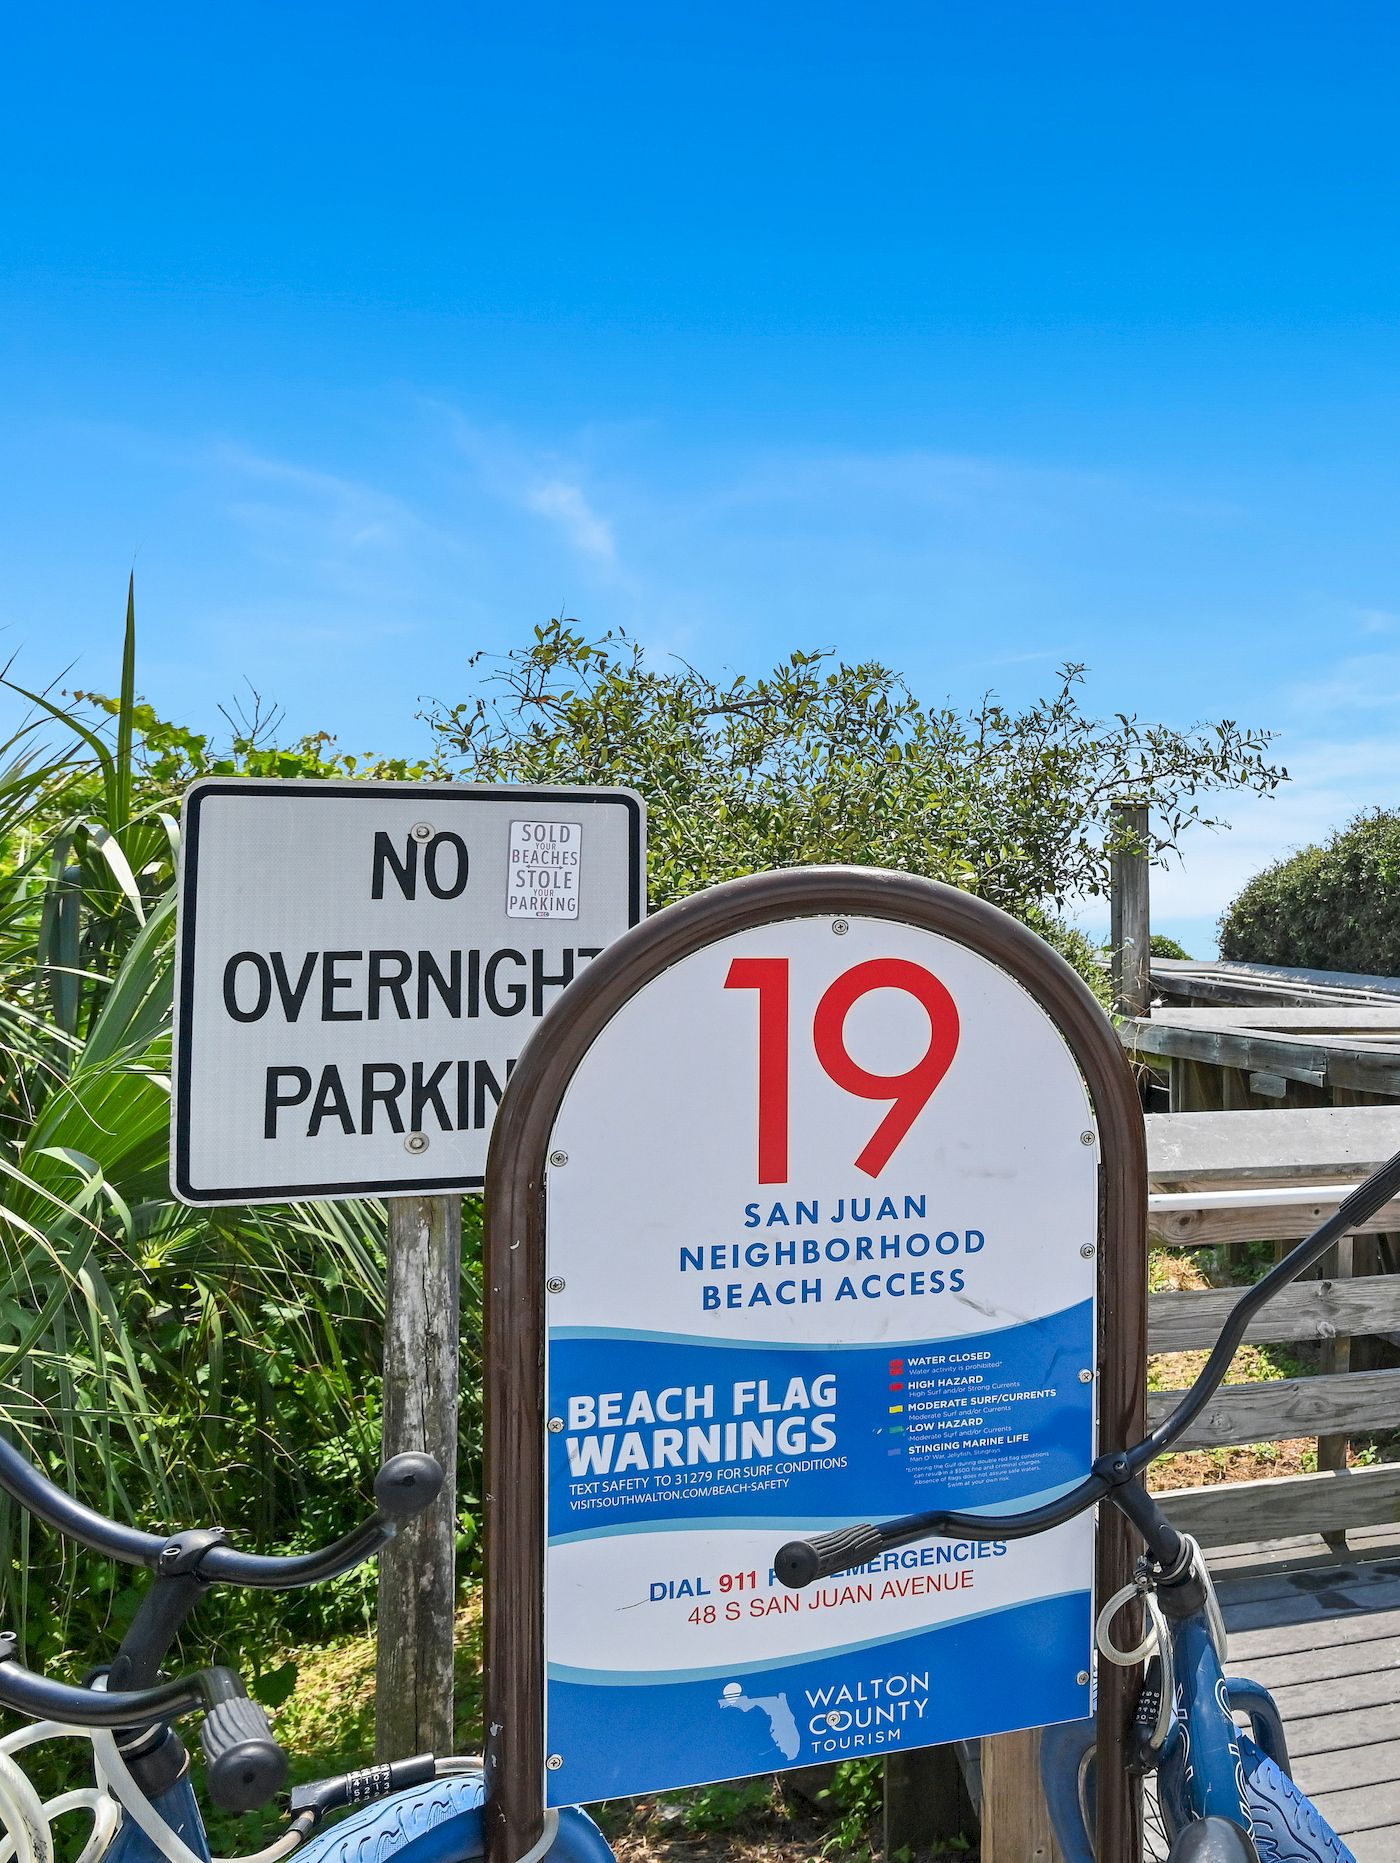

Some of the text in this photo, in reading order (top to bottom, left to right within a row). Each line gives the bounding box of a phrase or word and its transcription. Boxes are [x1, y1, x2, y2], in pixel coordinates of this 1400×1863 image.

[522, 824, 570, 843] SOLD
[371, 832, 468, 900] NO
[512, 849, 578, 866] BEACHES
[516, 870, 572, 888] STOLE
[510, 896, 576, 911] PARKING
[223, 948, 605, 1022] OVERNIGH
[723, 958, 960, 1184] 19
[264, 1060, 516, 1139] PARKIN
[744, 1194, 928, 1228] SAN JUAN
[679, 1230, 985, 1272] NEIGHBORHOOD
[701, 1268, 966, 1311] BEACH ACCESS
[908, 1352, 991, 1366] WATER CLOSED
[932, 1366, 956, 1374] activity
[908, 1376, 983, 1390] HIGH HAZARD
[908, 1389, 1056, 1411] MODERATE SURF/CURRENTS
[568, 1374, 837, 1431] BEACH FLAG
[909, 1418, 983, 1432] LOW HAZARD
[565, 1413, 837, 1477] WARNINGS
[909, 1434, 1029, 1454] STINGING MARINE LIFE
[569, 1456, 848, 1496] TEXT SAFETY TO 31279 FOR SURF CONDITIONS
[570, 1478, 790, 1511] VISITSOUTHWALTON.COM/BEACH-SAFETY
[650, 1576, 712, 1602] DIAL
[718, 1570, 758, 1593] 911
[830, 1539, 1008, 1578] MERGENCIES
[687, 1569, 975, 1626] 48 S SAN JUAN AVENUE
[805, 1672, 929, 1709] WALTON
[808, 1698, 928, 1735] COUNTY
[811, 1728, 900, 1754] TOURISM
